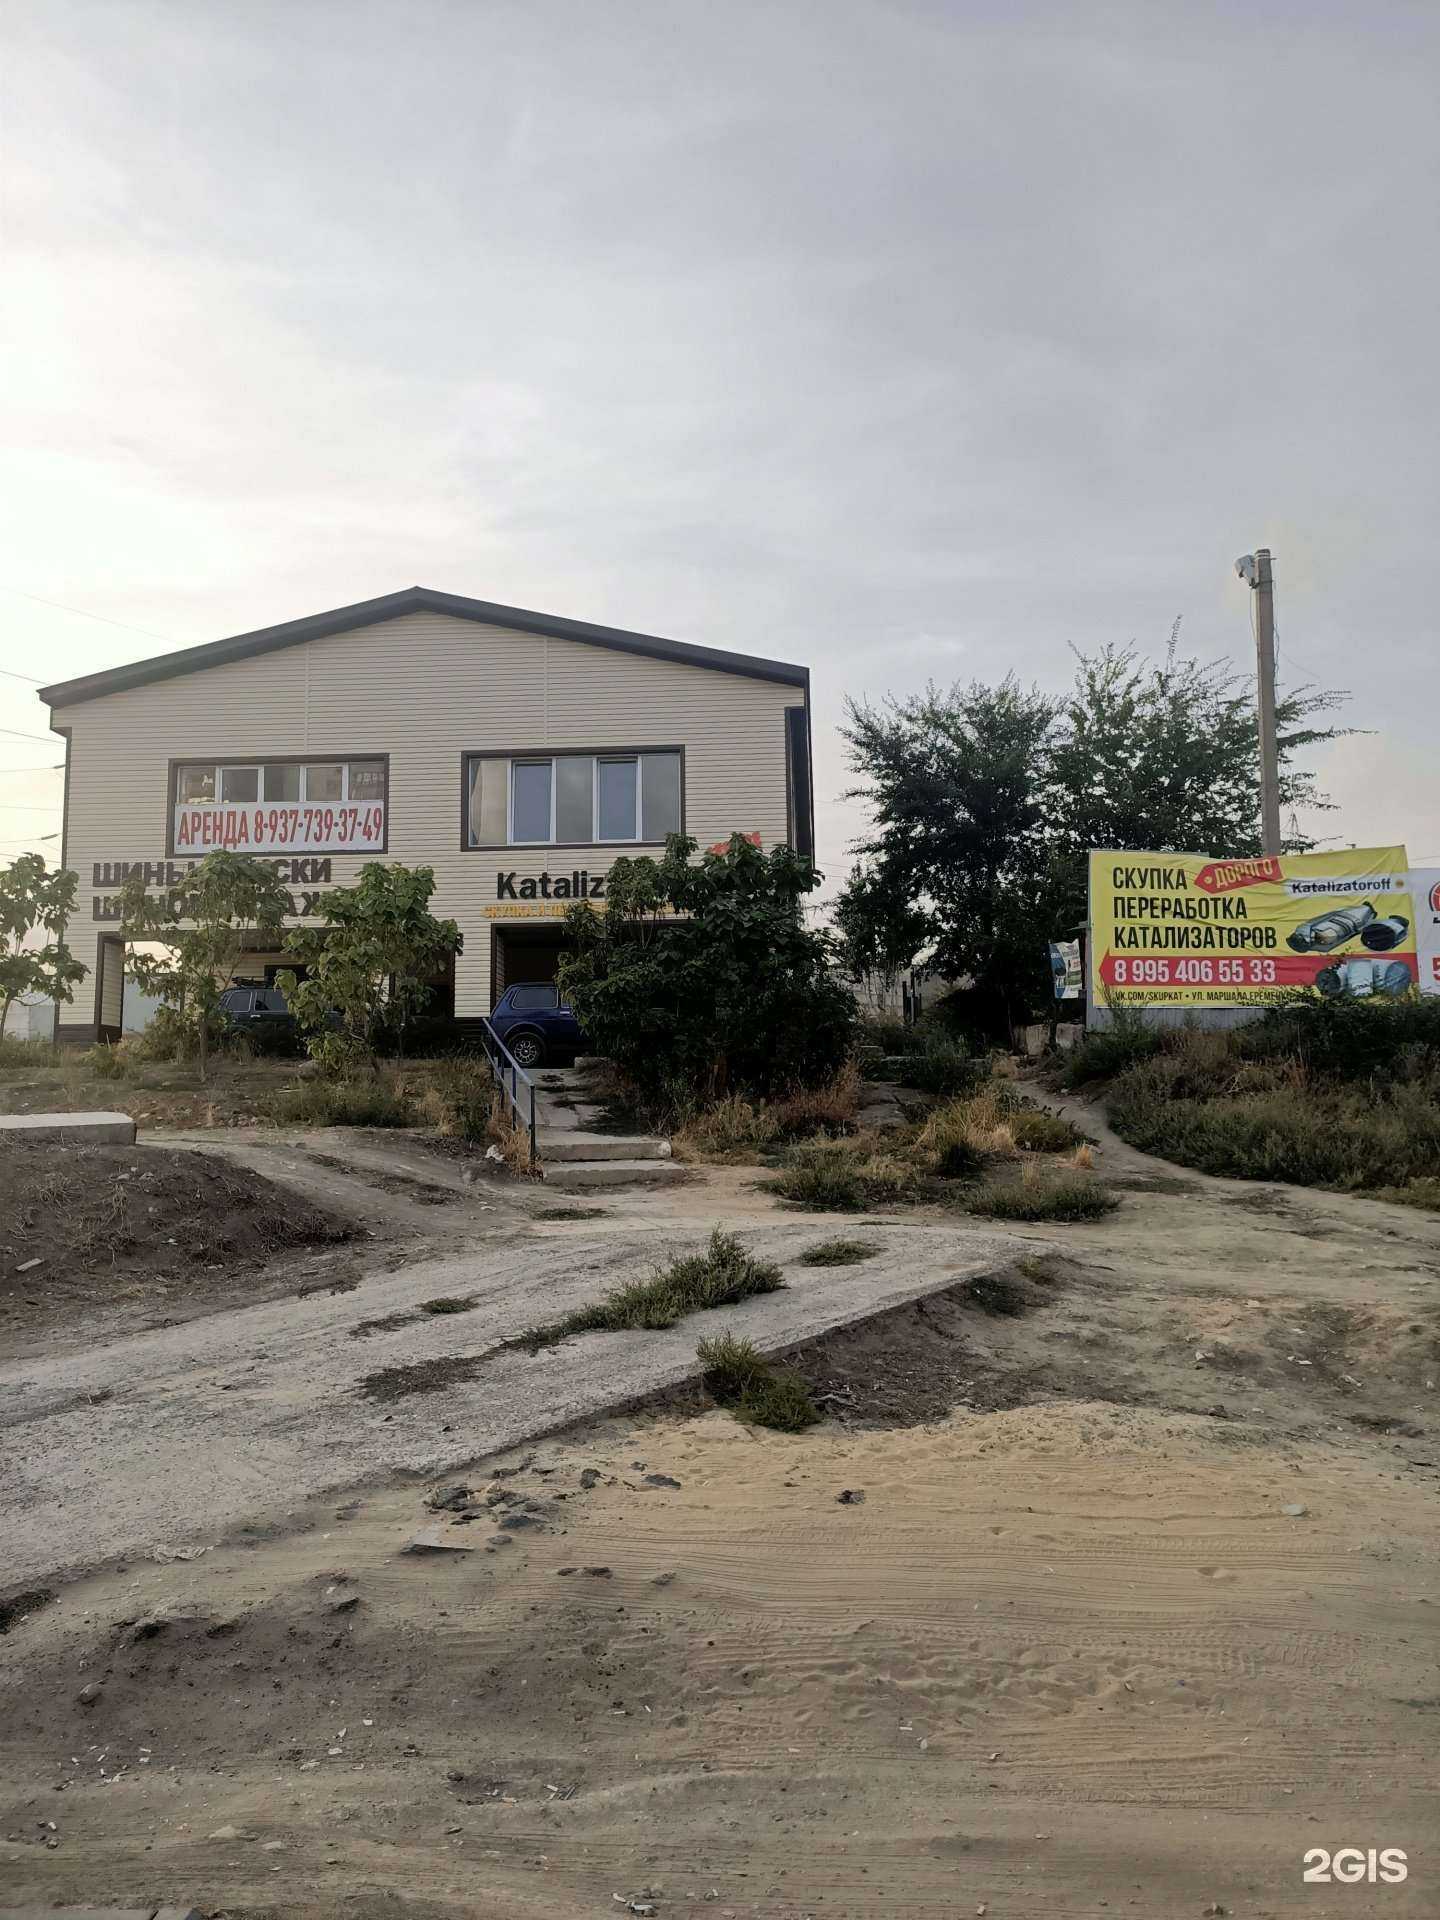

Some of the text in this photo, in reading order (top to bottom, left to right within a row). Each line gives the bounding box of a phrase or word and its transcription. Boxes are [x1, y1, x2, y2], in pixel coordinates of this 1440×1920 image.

[177, 811, 250, 849] АРЕНДА
[497, 871, 607, 900] Kataliz
[1112, 867, 1188, 890] СКУПКА
[1214, 859, 1274, 889] ДОРОГО
[1291, 878, 1391, 894] Katalizatoroff
[1113, 897, 1248, 919] ПЕРЕРАБОТКА
[1114, 926, 1277, 949] КАТАЛИЗАТОРОВ
[1114, 959, 1276, 982] 8 995 406 55 33
